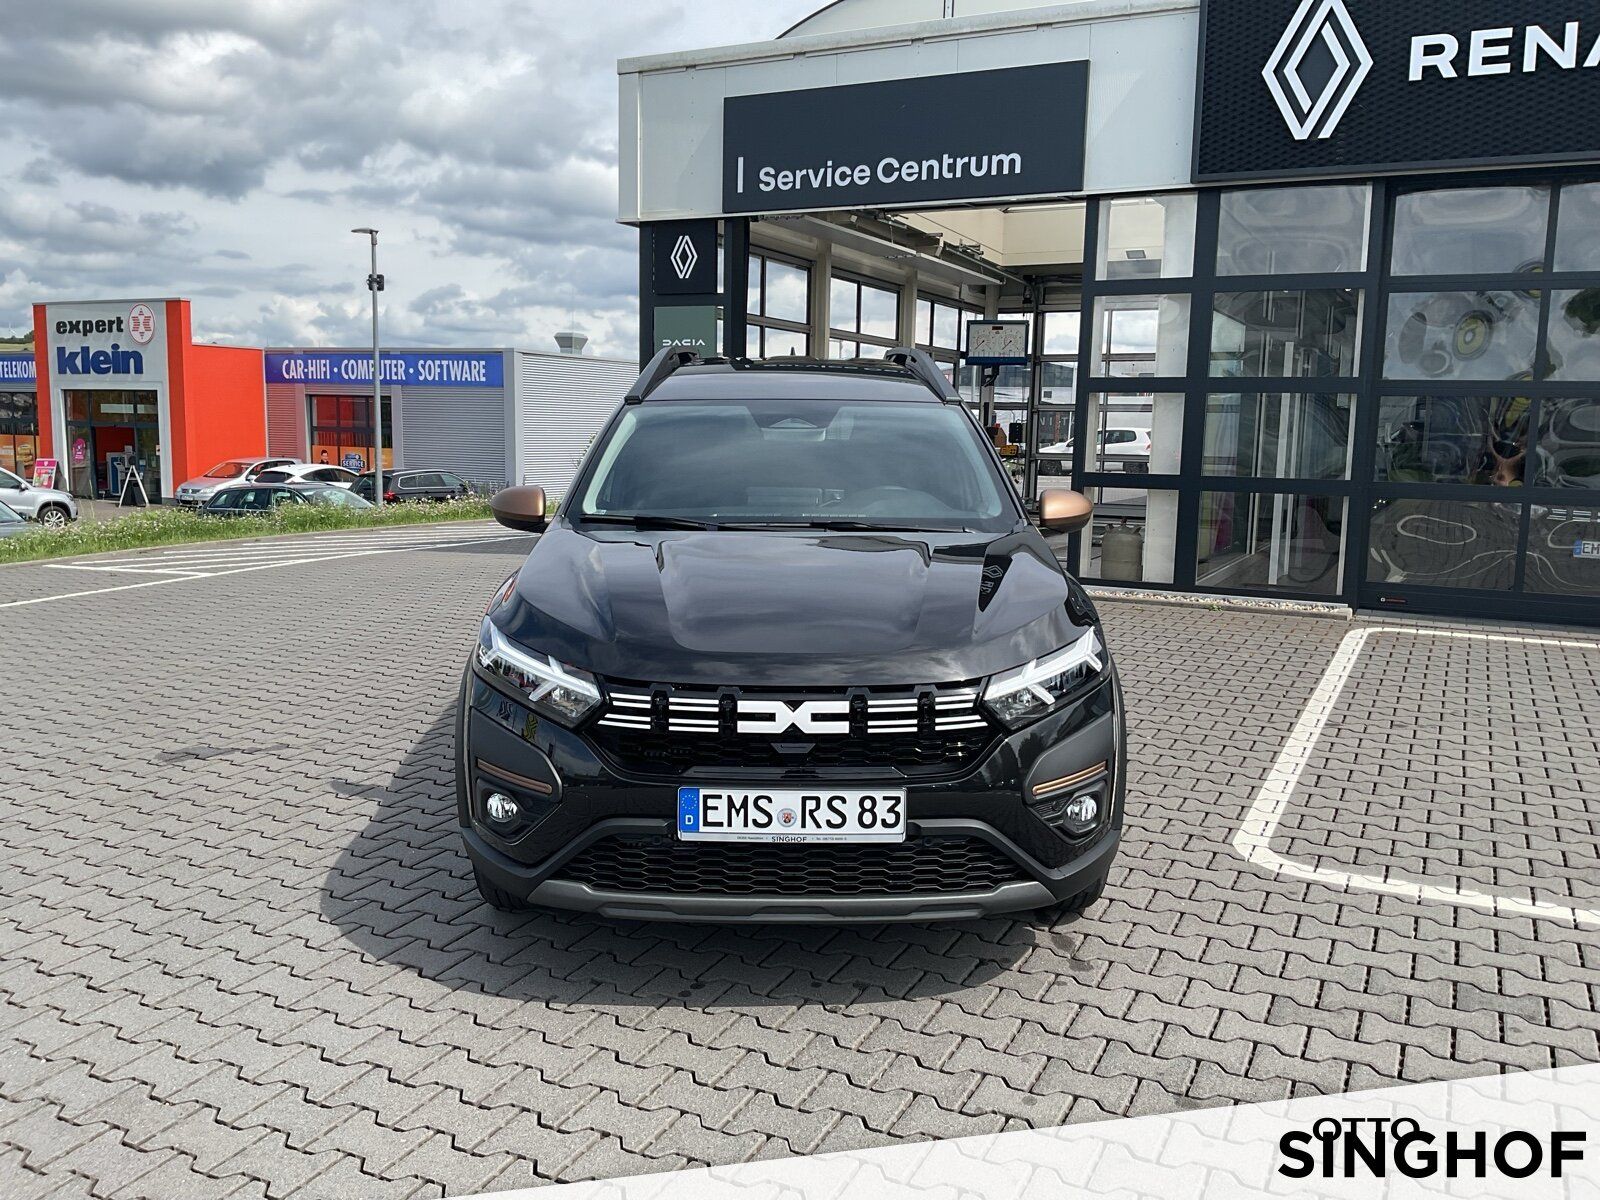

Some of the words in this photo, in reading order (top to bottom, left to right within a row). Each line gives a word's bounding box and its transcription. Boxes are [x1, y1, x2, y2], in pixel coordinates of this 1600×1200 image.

[759, 161, 871, 192] Service
[876, 152, 1022, 184] Centrum
[56, 316, 124, 336] expert
[57, 343, 144, 375] klein
[282, 359, 330, 379] CAR-HIFI
[417, 360, 486, 382] SOFTWARE
[685, 815, 694, 825] D
[702, 794, 773, 829] EMS
[801, 796, 847, 829] RS
[857, 796, 901, 829] 83
